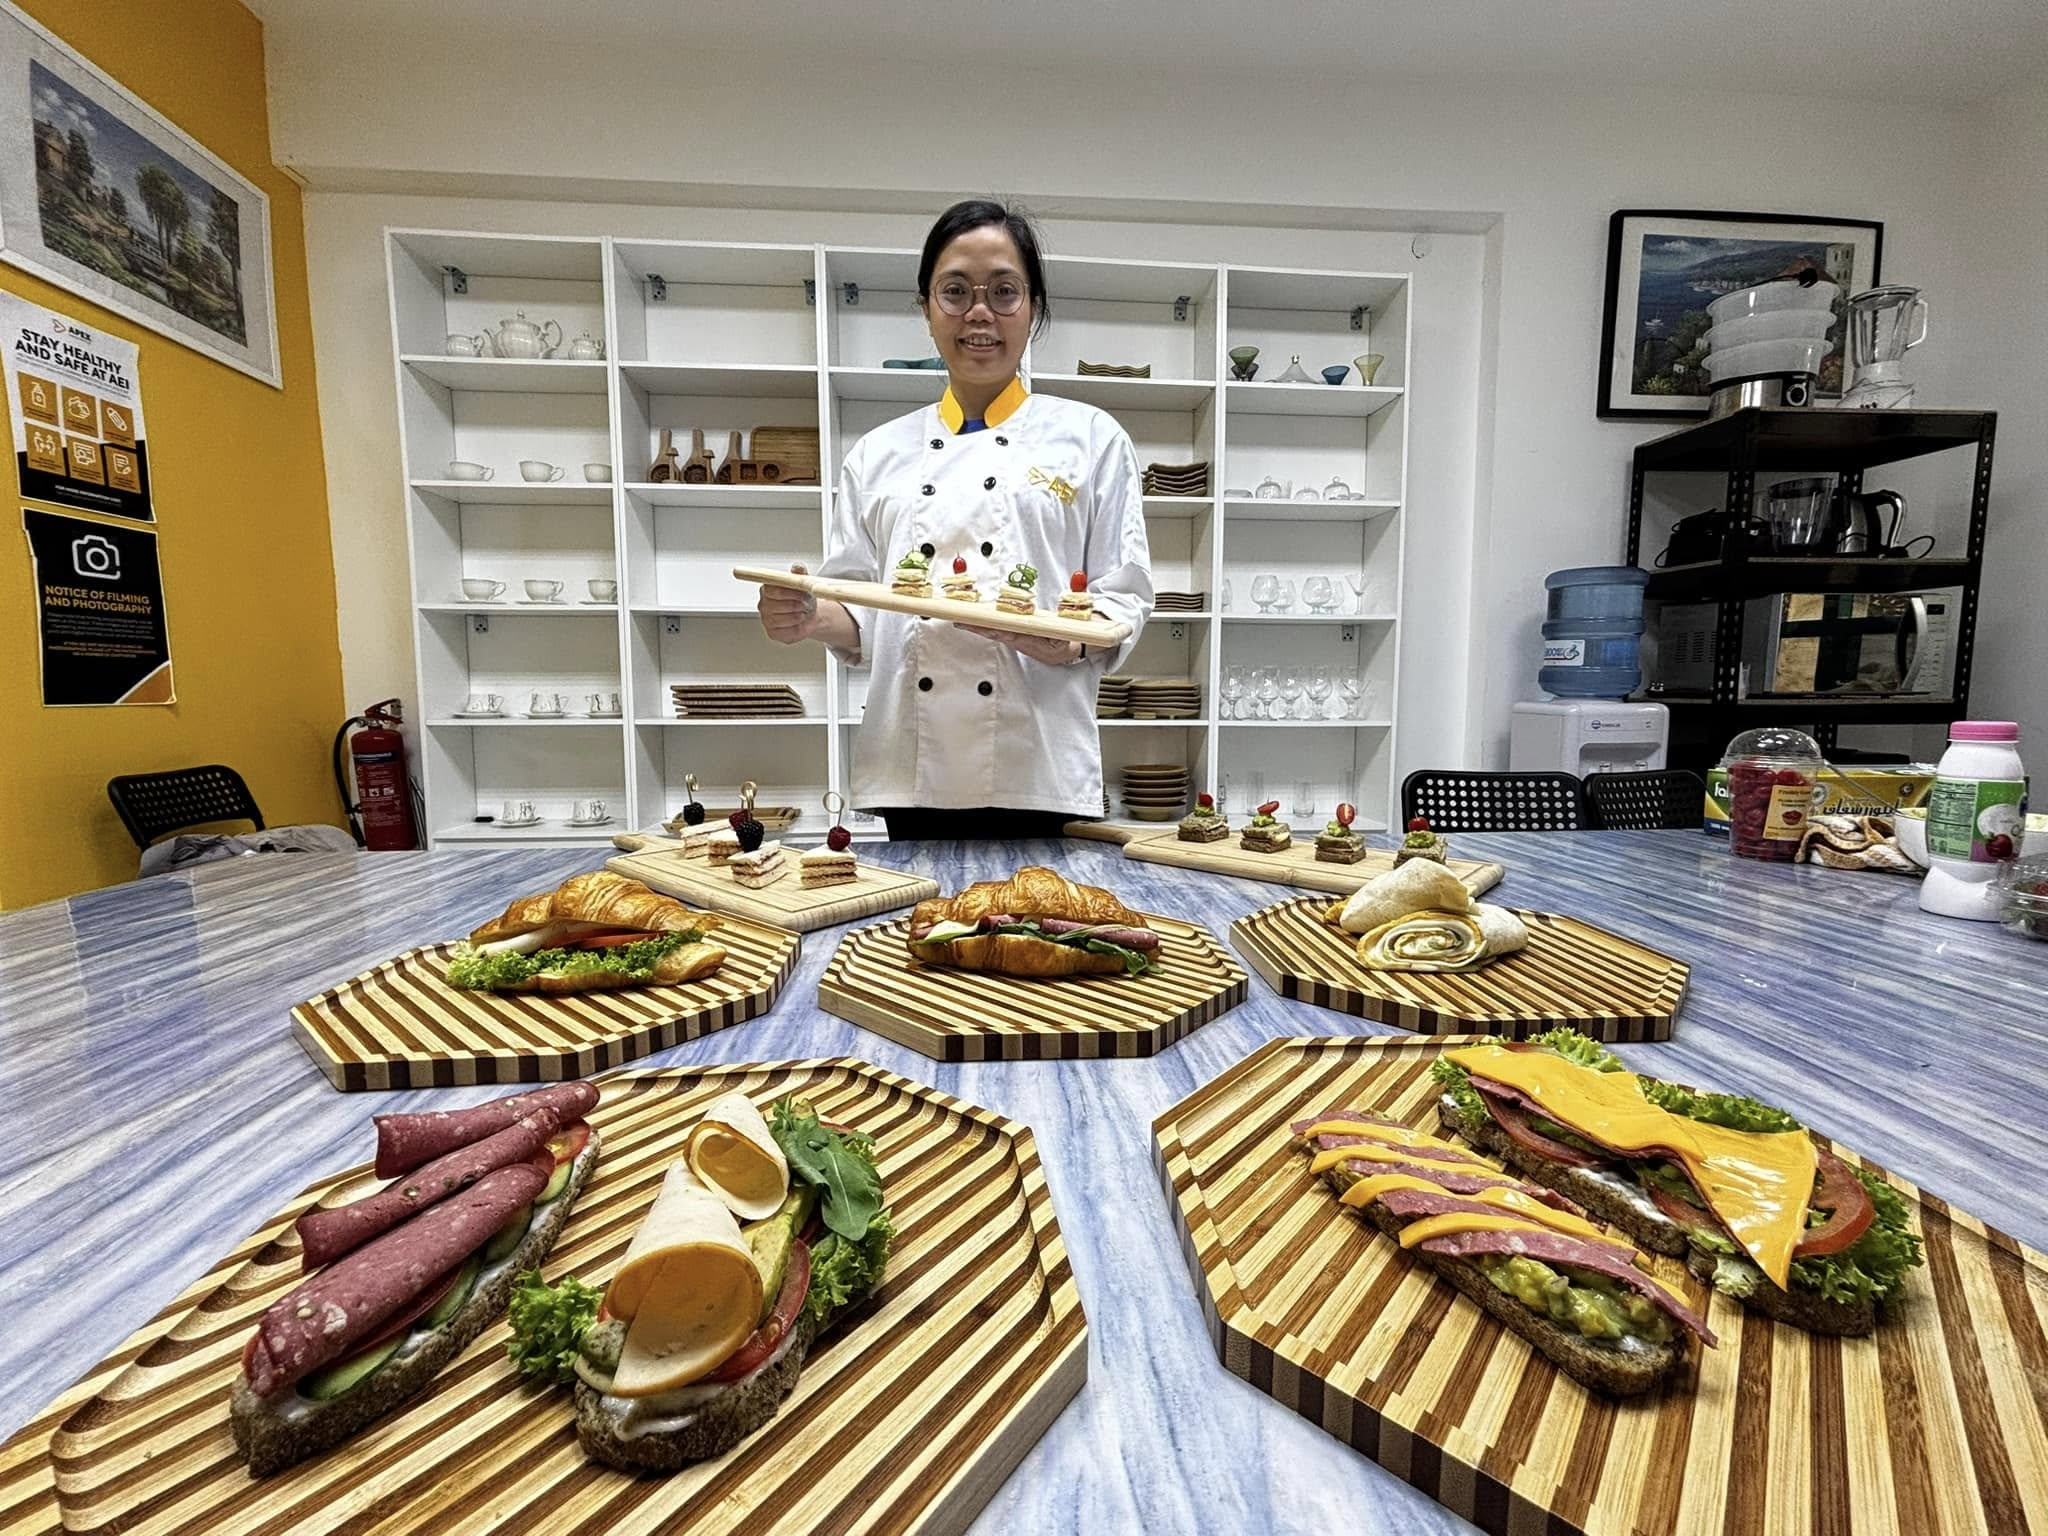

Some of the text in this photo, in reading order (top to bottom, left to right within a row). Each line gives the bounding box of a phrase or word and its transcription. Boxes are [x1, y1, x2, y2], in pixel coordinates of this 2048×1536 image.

[15, 341, 129, 390] AND SAFE AT AEI
[21, 329, 122, 374] STAY HEALTHY
[45, 585, 150, 605] NOTICE OF FILMING
[45, 596, 153, 615] AND PHOTOGRAPHY
